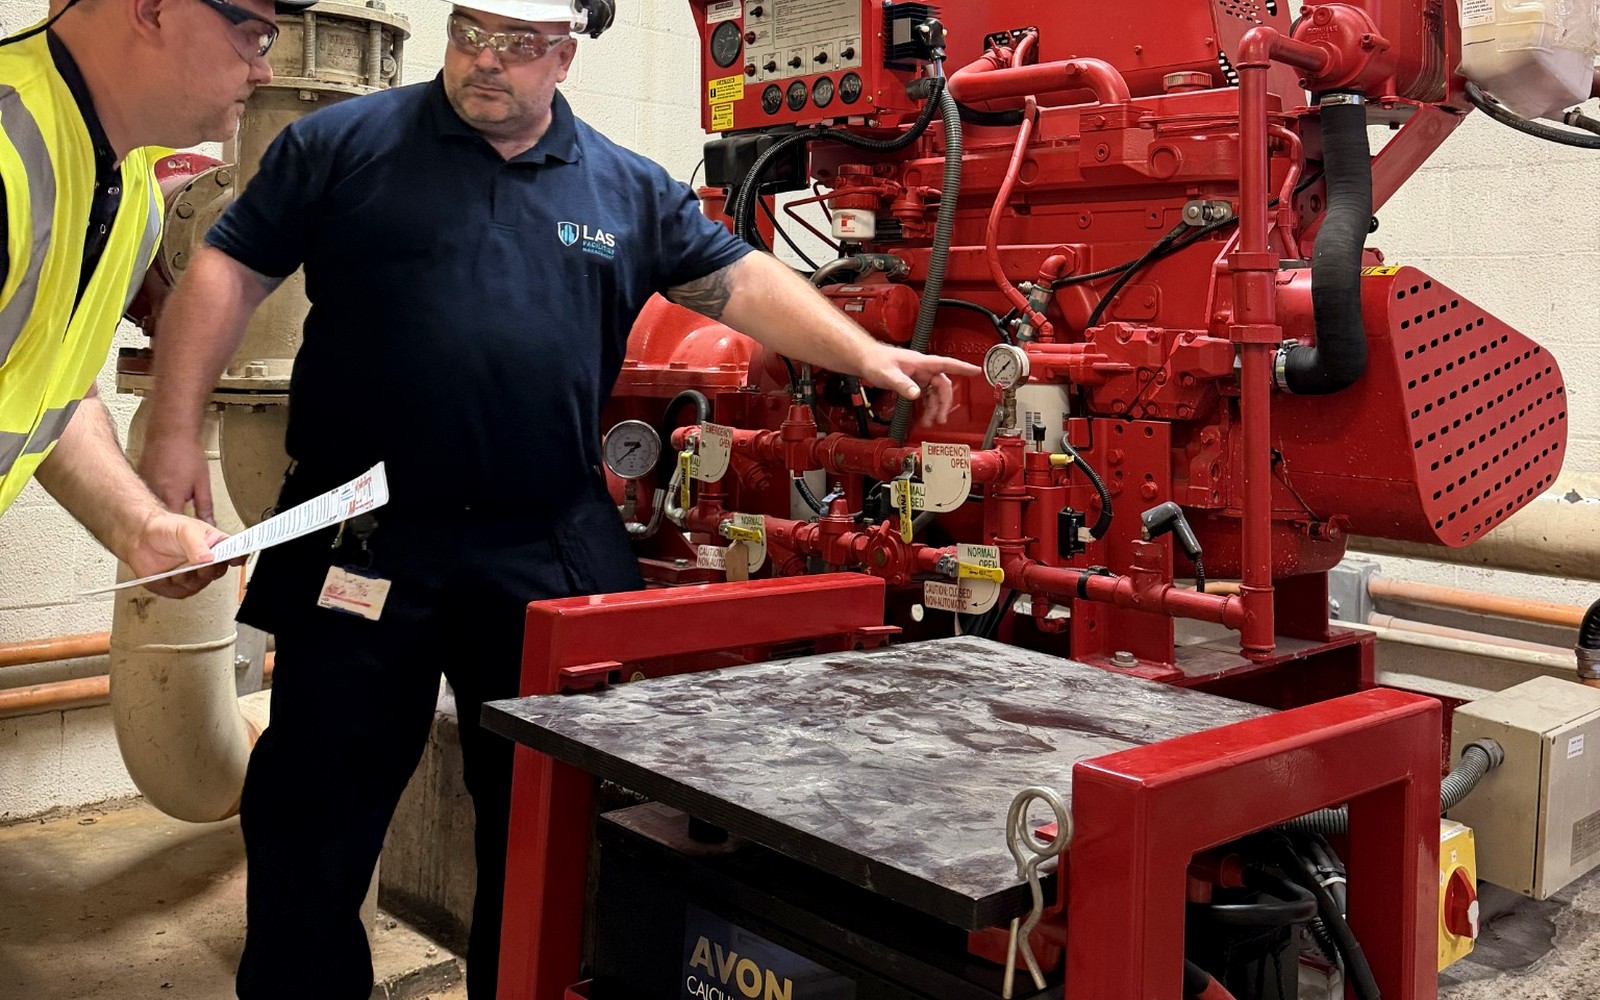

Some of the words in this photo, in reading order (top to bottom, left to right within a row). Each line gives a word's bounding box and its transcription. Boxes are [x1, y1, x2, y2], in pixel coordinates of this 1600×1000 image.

[583, 225, 616, 248] LAS
[950, 457, 970, 469] OPEN
[689, 935, 793, 1000] AVON
